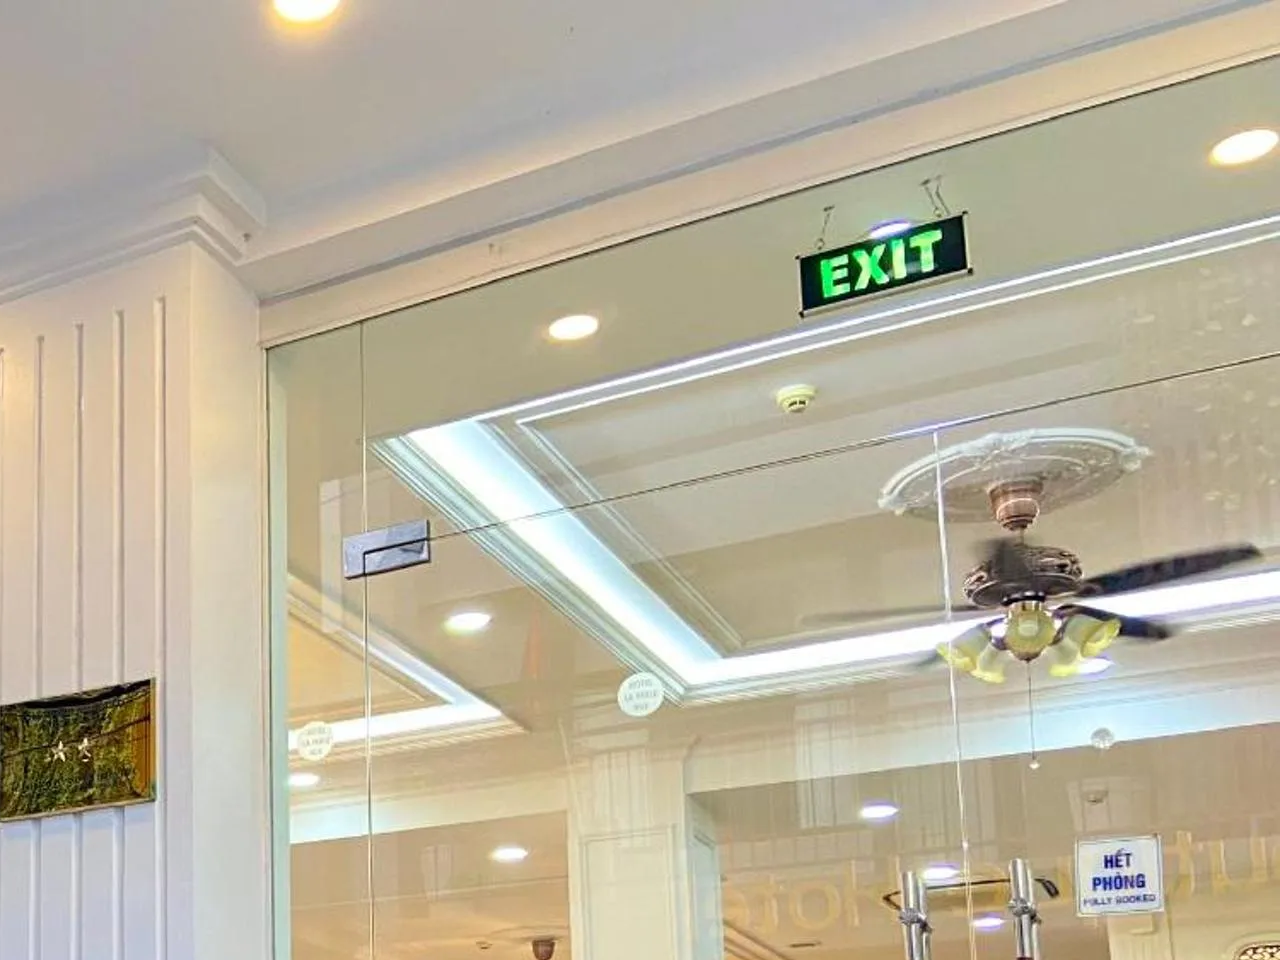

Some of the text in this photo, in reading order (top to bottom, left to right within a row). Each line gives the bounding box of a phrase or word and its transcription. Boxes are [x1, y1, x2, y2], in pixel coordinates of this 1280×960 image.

[820, 229, 942, 298] EXIT
[1103, 848, 1132, 869] HẾT
[1092, 872, 1146, 891] PHÒNG
[1083, 894, 1156, 906] FULLY BOOKED
